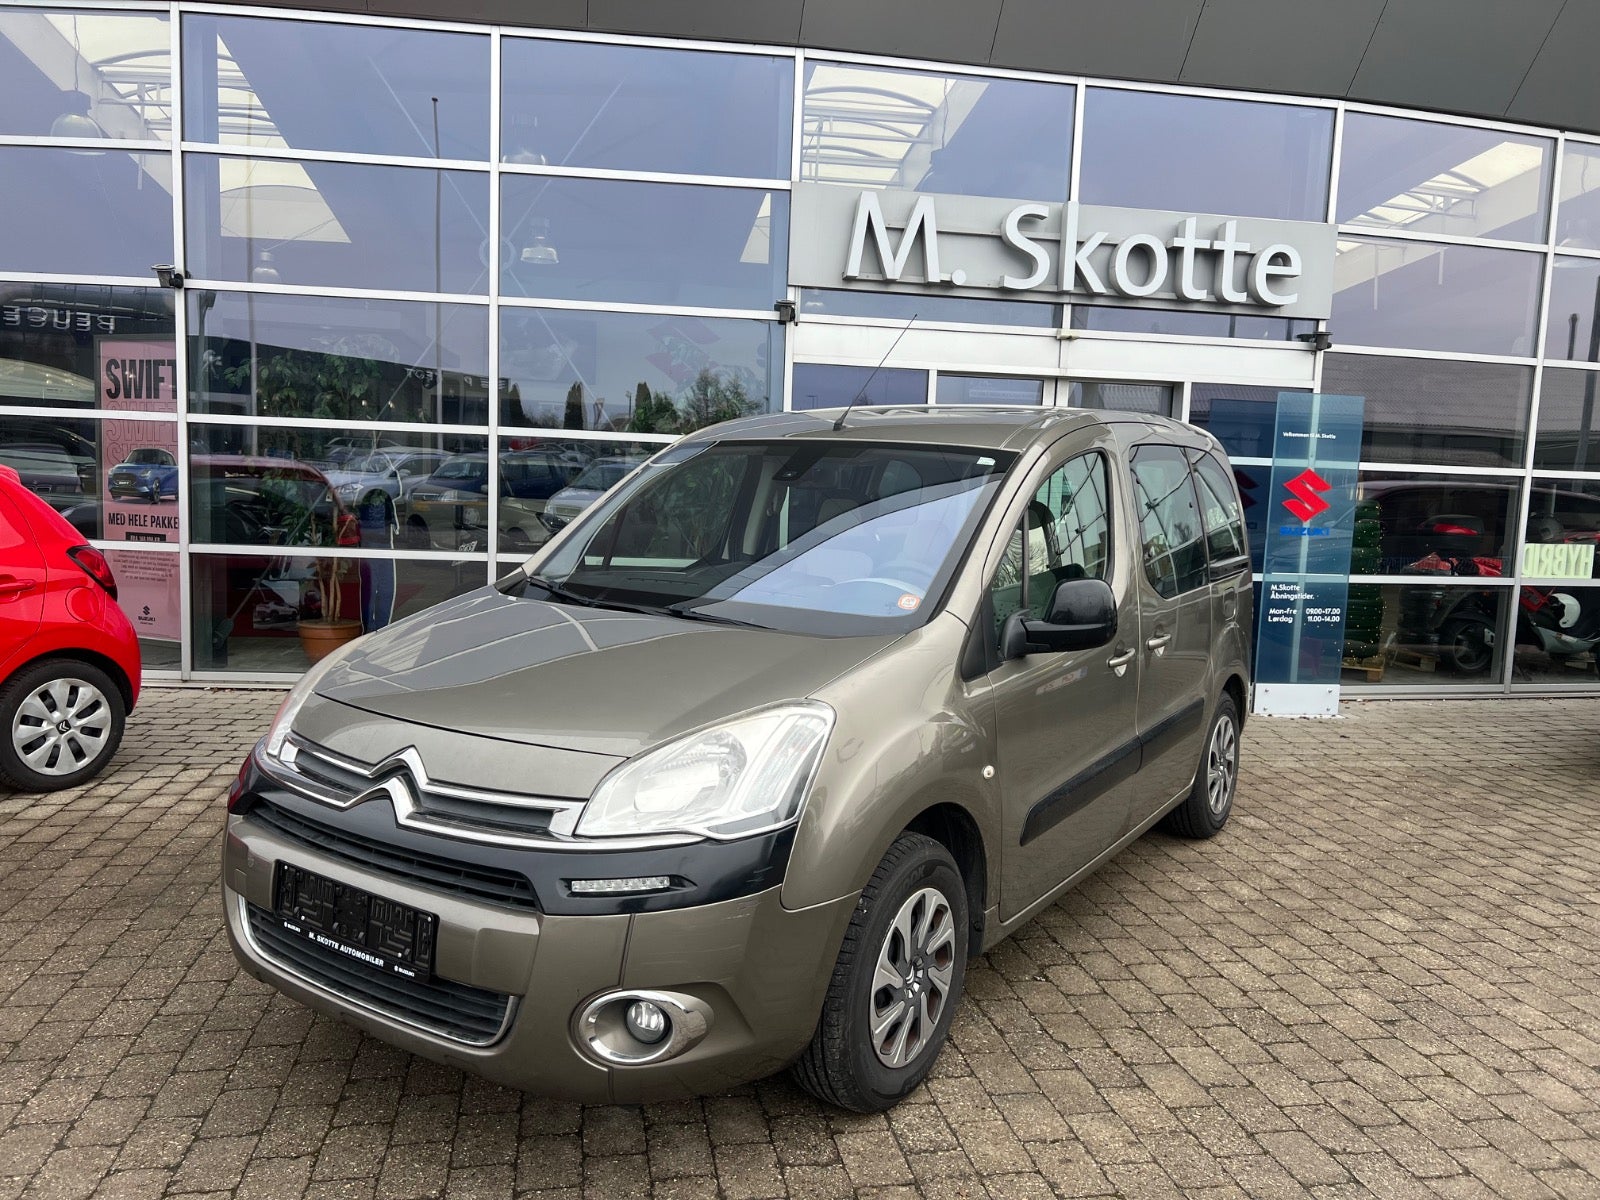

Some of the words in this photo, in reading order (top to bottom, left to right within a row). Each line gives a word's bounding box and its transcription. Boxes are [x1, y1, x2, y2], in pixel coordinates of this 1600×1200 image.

[842, 190, 967, 287] M.
[1000, 200, 1302, 307] Skotte
[106, 358, 177, 399] SWIFT
[108, 512, 126, 525] MED
[128, 513, 148, 527] HELE
[1280, 526, 1330, 536] SUZUKI
[308, 931, 316, 940] M.
[316, 934, 340, 950] SKOTTE
[339, 944, 384, 967] AUTOMOBILER
